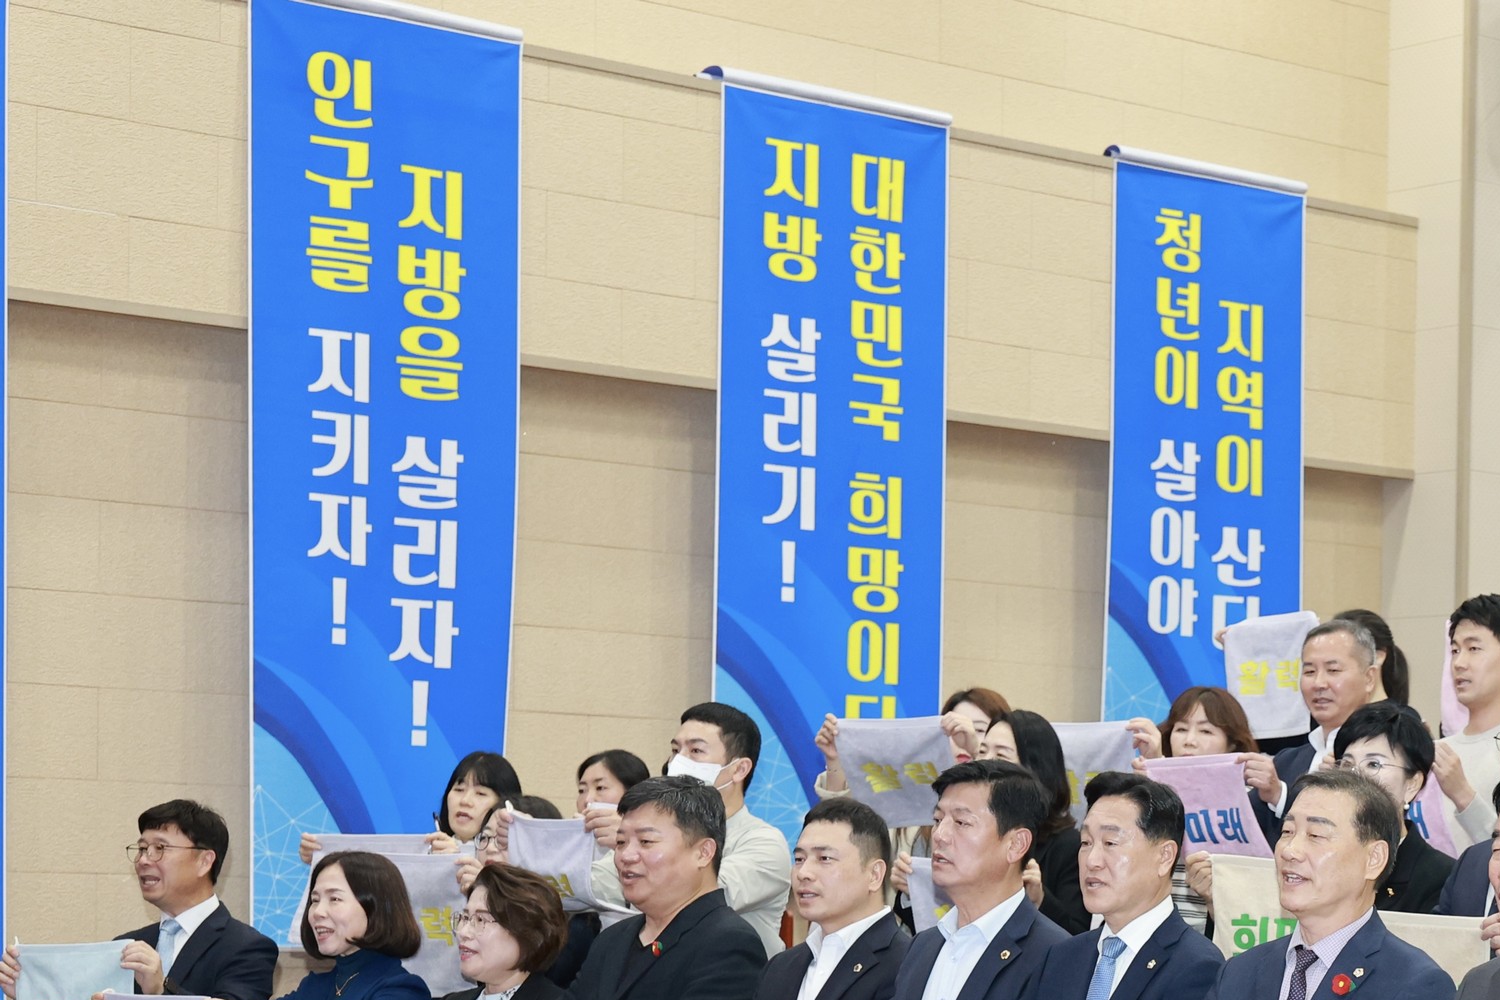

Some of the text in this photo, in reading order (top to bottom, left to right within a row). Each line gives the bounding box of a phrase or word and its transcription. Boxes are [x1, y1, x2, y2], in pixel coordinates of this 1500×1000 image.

[305, 50, 374, 646] 인구를 지키자!
[388, 164, 468, 748] 지방을 살리자!
[760, 137, 822, 604] 지방 살리기!
[849, 152, 907, 442] 대한민국
[1147, 207, 1203, 639] 청년이 살아야
[1216, 300, 1266, 499] 지역이
[417, 906, 456, 947] 력
[1183, 807, 1249, 845] 미래
